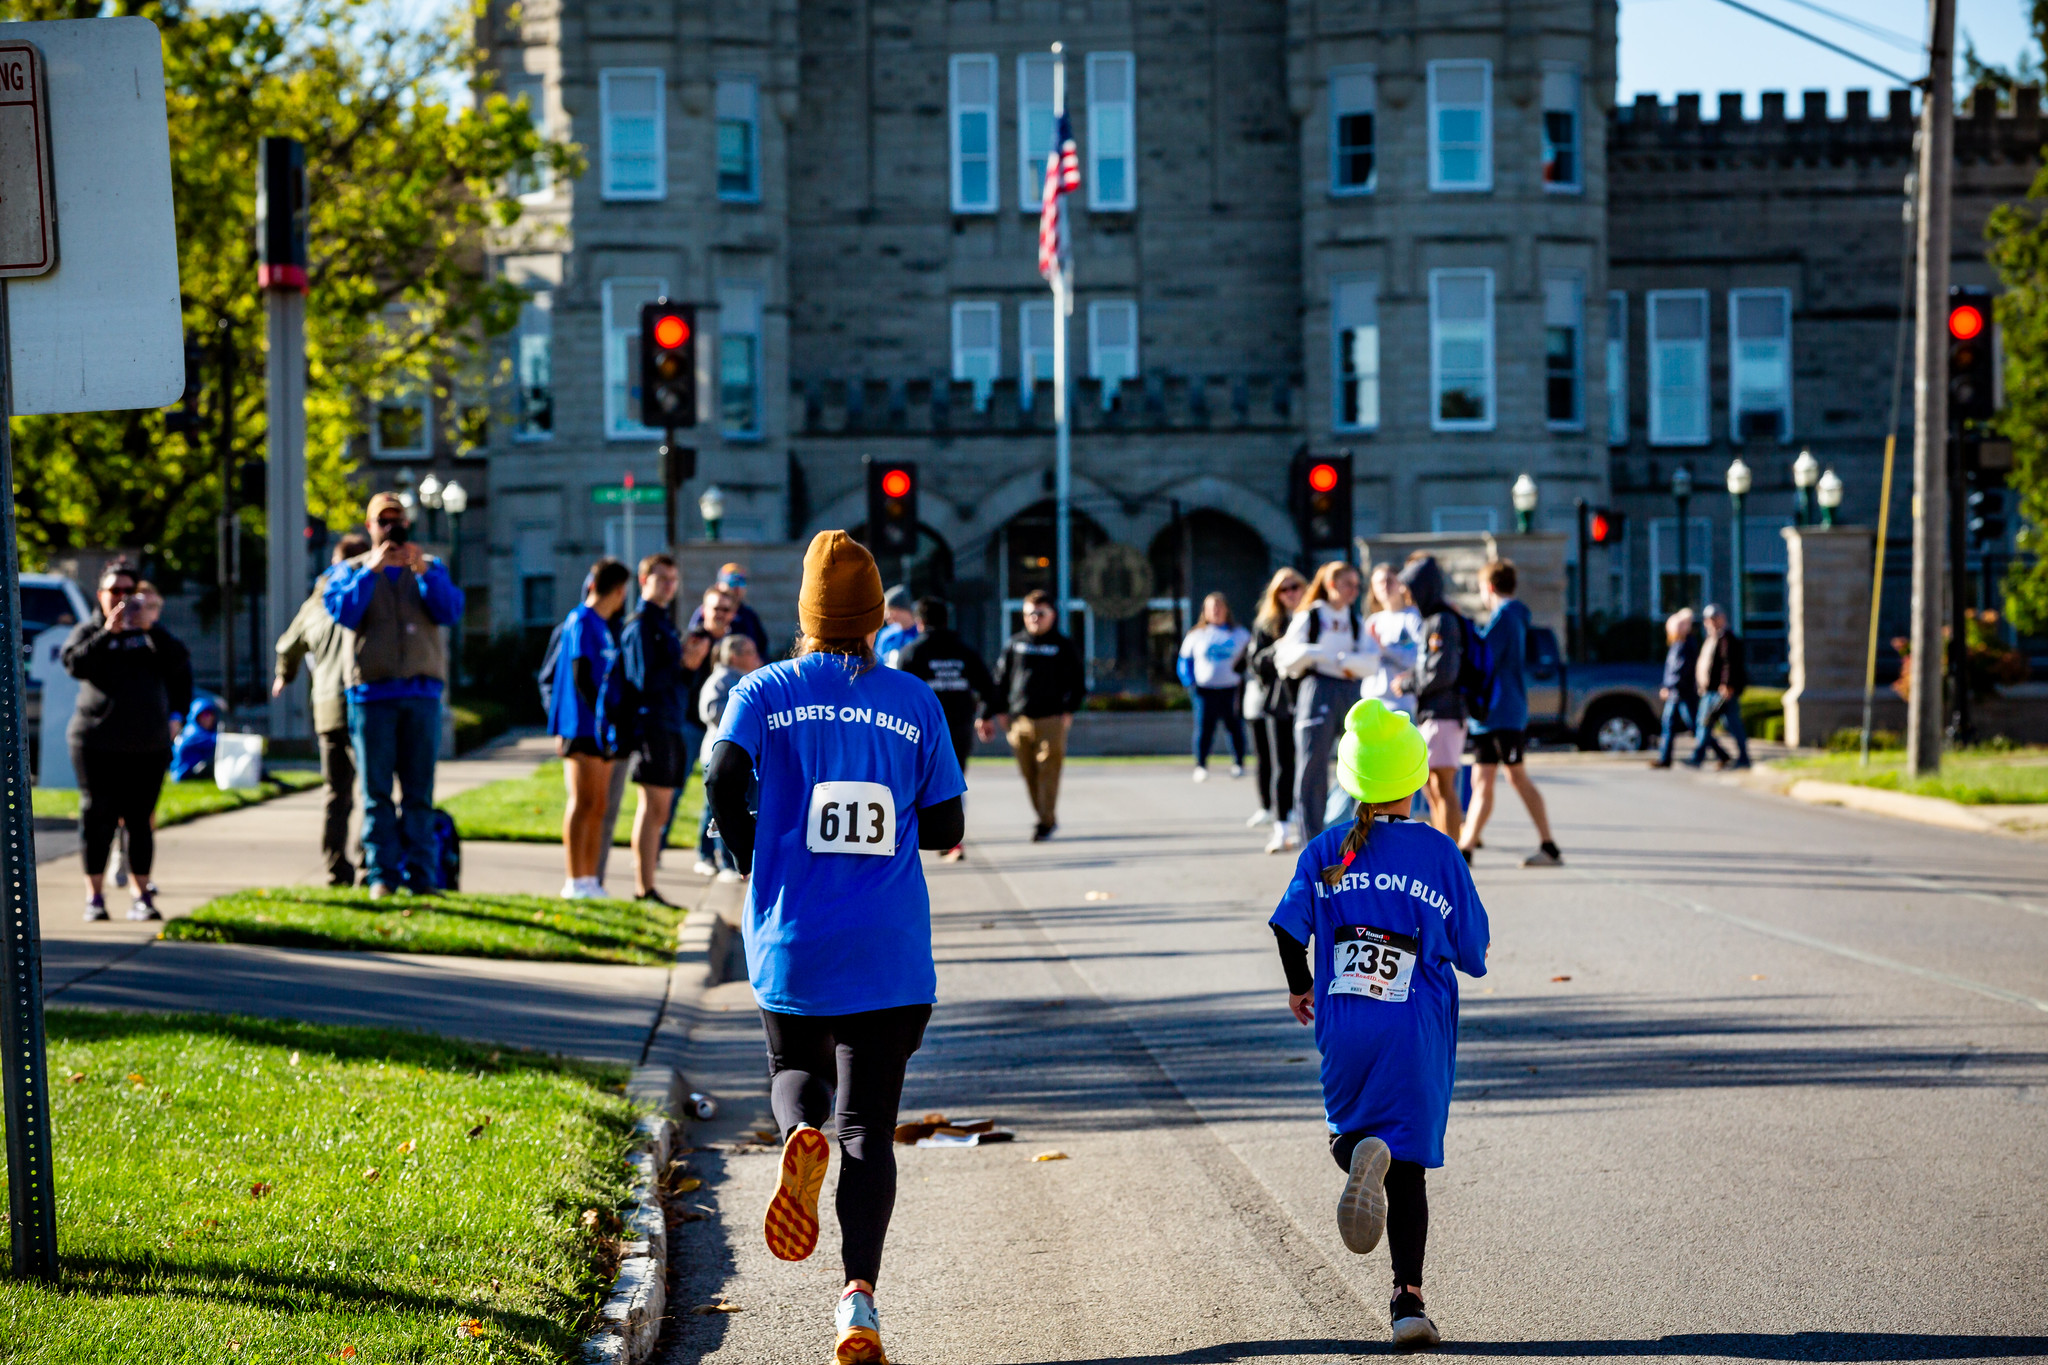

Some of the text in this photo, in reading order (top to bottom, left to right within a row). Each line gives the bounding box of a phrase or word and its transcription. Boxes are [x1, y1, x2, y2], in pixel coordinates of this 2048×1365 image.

[767, 704, 921, 744] EIU BETS ON BLUE!
[819, 801, 885, 844] 613
[1374, 873, 1408, 892] ON
[1409, 879, 1453, 920] BLUE!
[1343, 943, 1401, 981] 235
